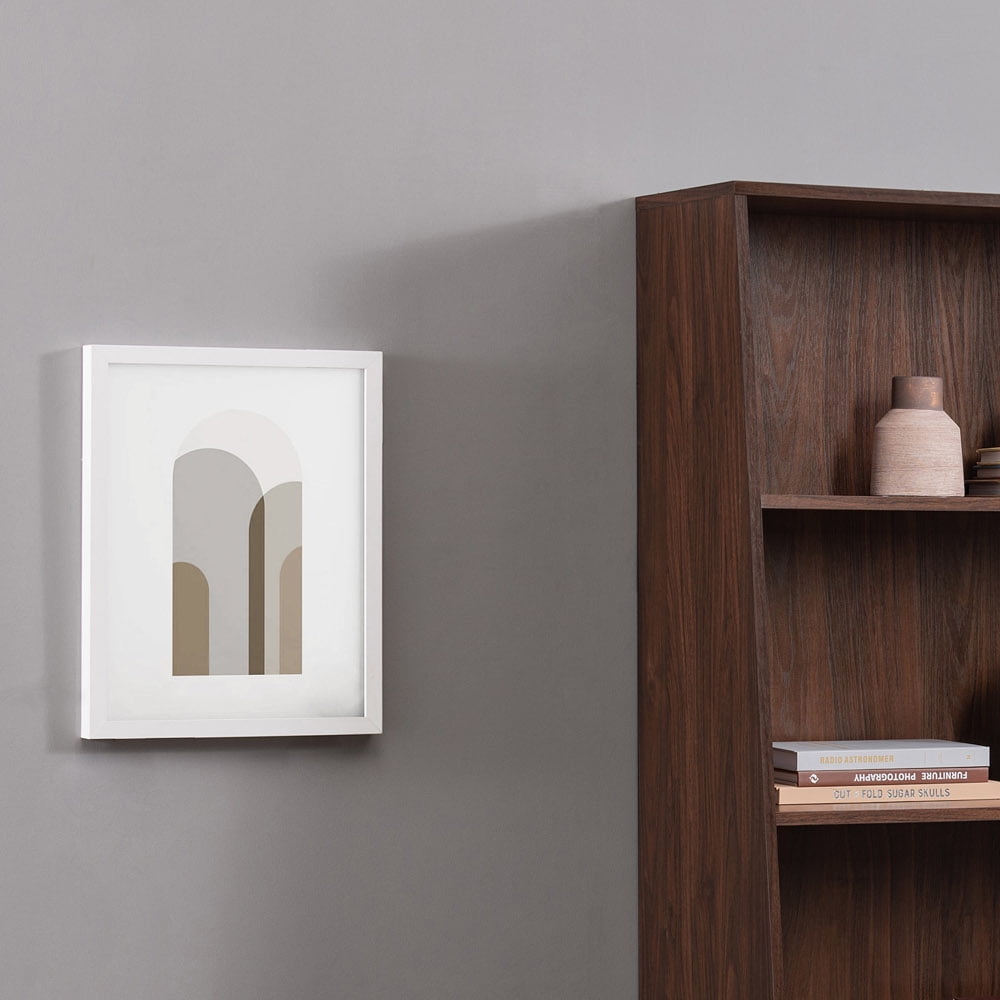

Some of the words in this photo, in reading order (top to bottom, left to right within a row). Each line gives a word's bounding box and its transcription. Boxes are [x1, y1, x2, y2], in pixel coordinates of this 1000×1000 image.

[819, 755, 843, 765] RADIO
[844, 754, 895, 764] ASTRONOMER
[854, 772, 916, 783] PHOTOGRAPHY
[921, 771, 968, 781] FURNITURE
[833, 790, 850, 800] CUT
[861, 789, 883, 799] FOLD
[887, 788, 915, 798] SUGAR
[918, 787, 951, 798] SKULLS
